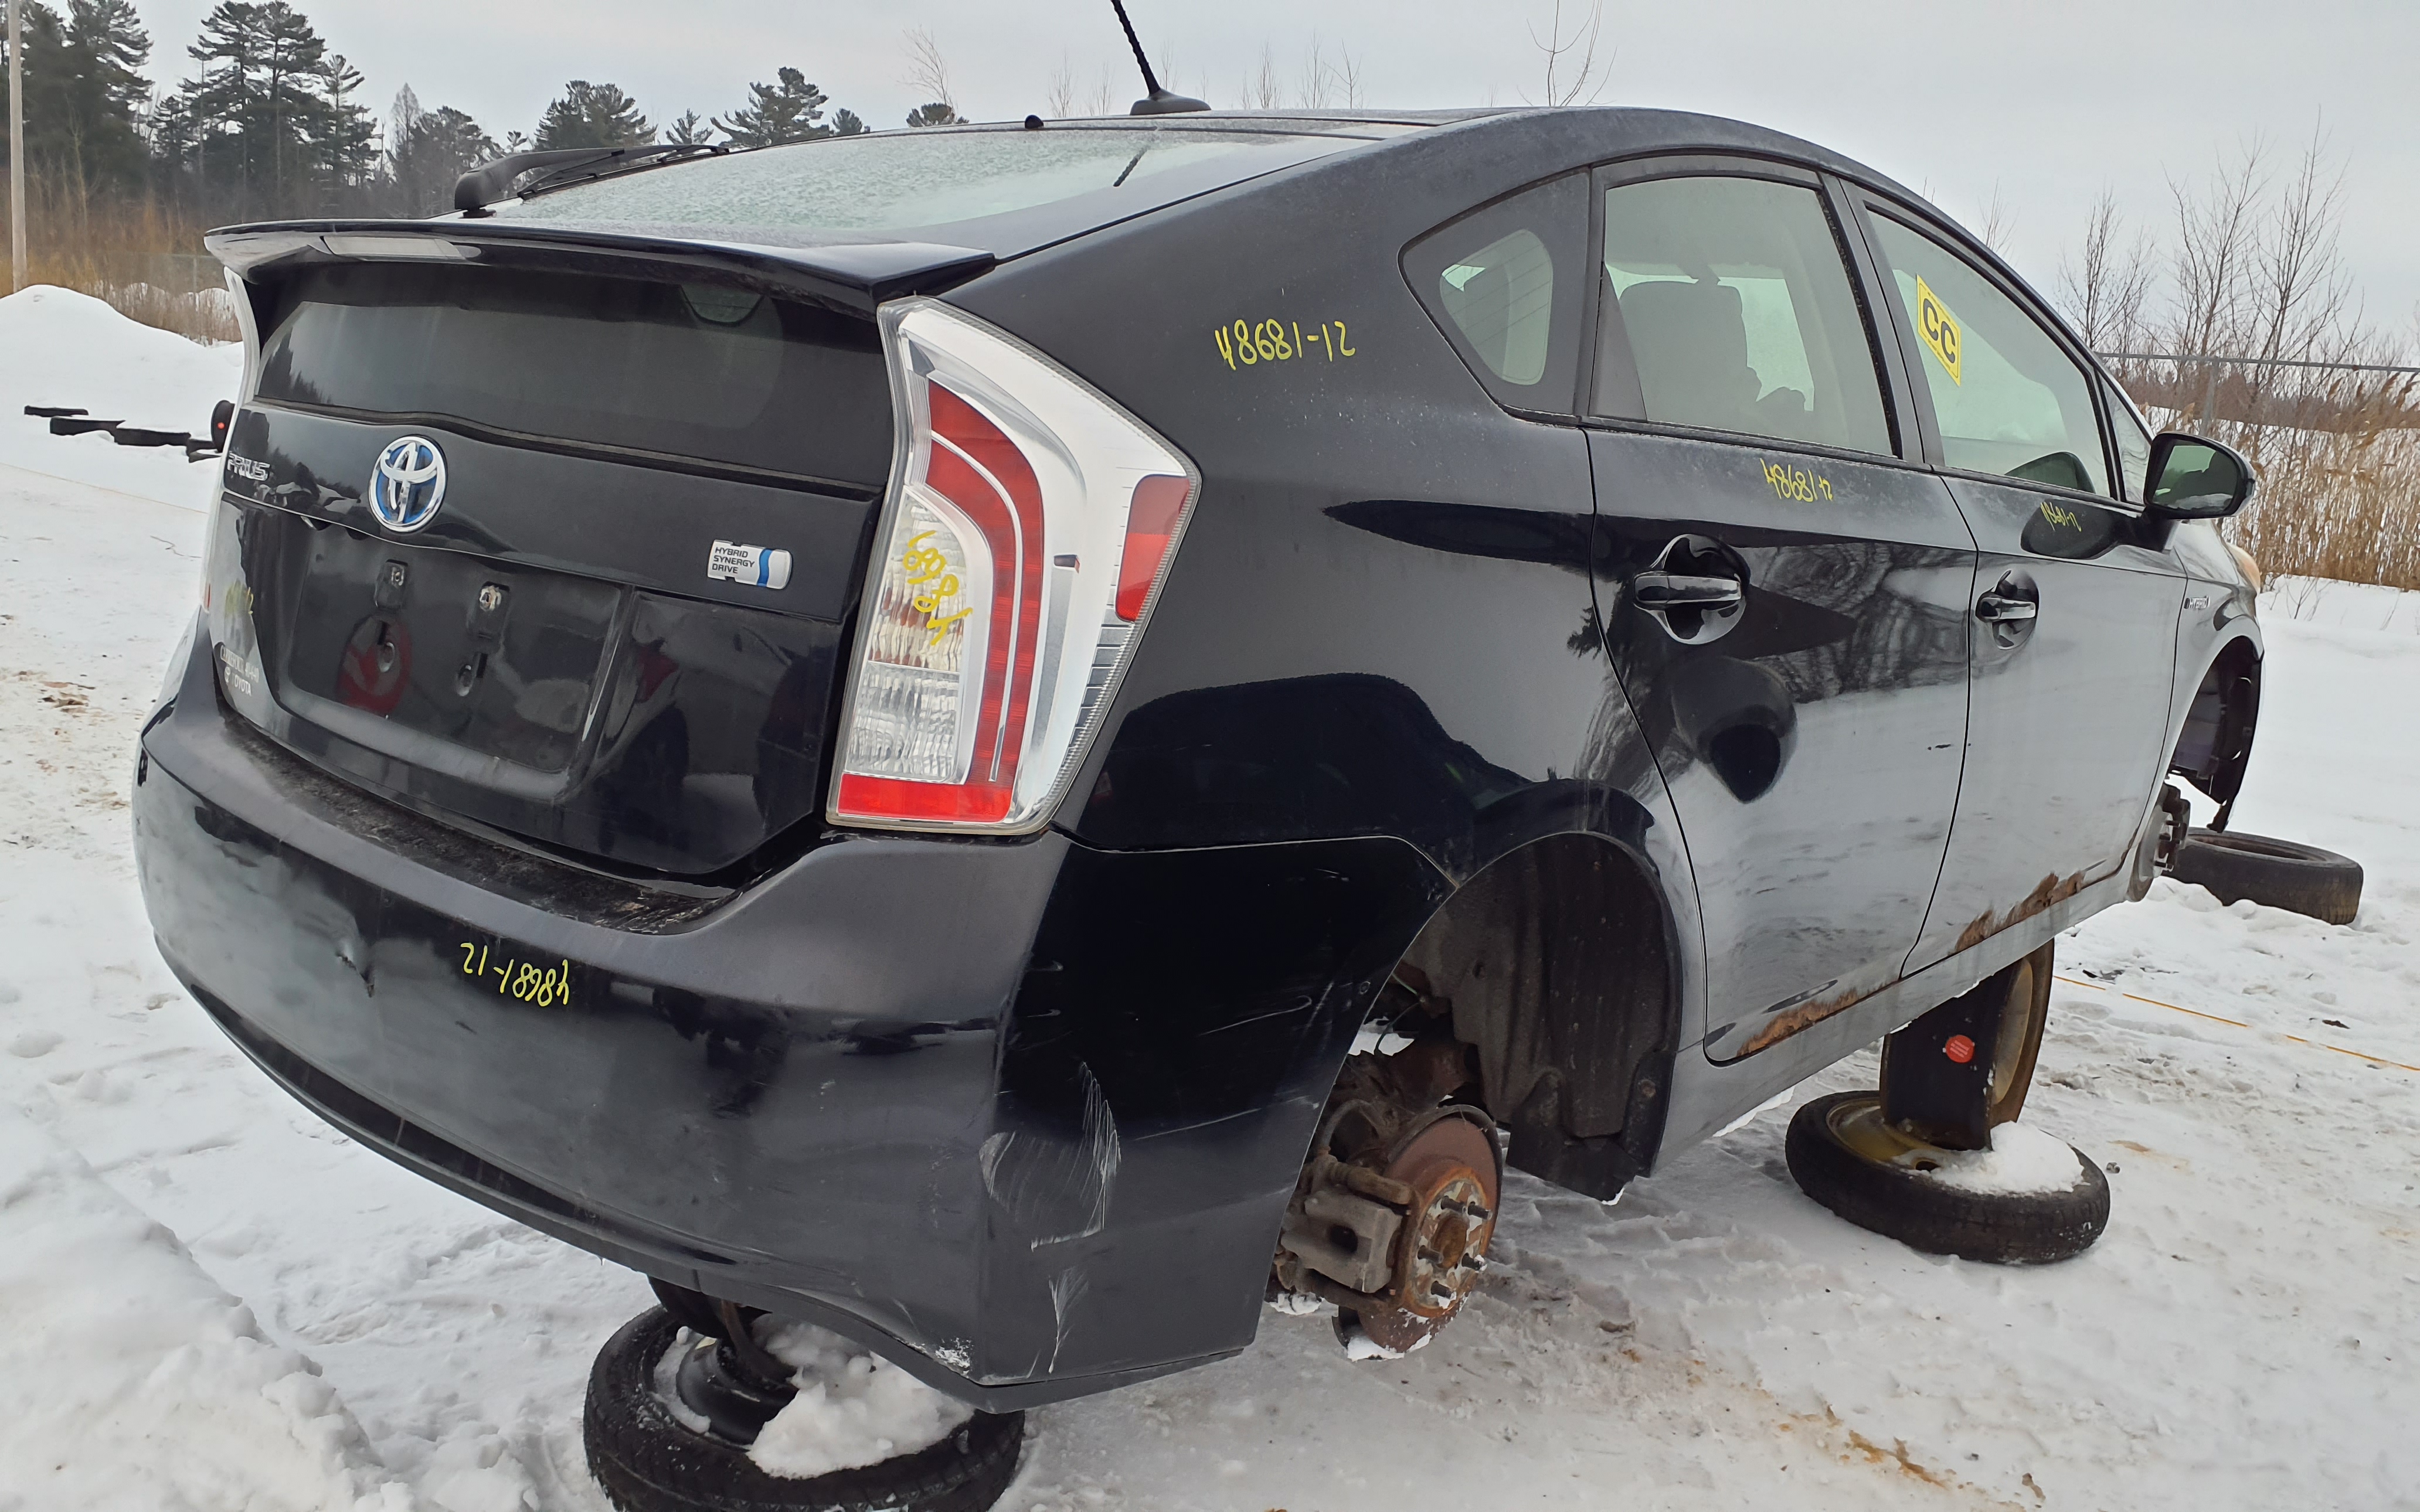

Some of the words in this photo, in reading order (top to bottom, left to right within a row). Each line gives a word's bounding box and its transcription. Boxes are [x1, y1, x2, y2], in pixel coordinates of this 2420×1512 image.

[1214, 318, 1355, 370] 48681-12
[1923, 298, 1956, 364] CC
[227, 451, 270, 481] PRIUS
[713, 555, 755, 568] SYNERGY
[715, 546, 748, 558] HYBRID
[712, 563, 739, 574] DRIVE
[232, 672, 251, 697] TOYOTA
[460, 942, 569, 1007] 48681-12
